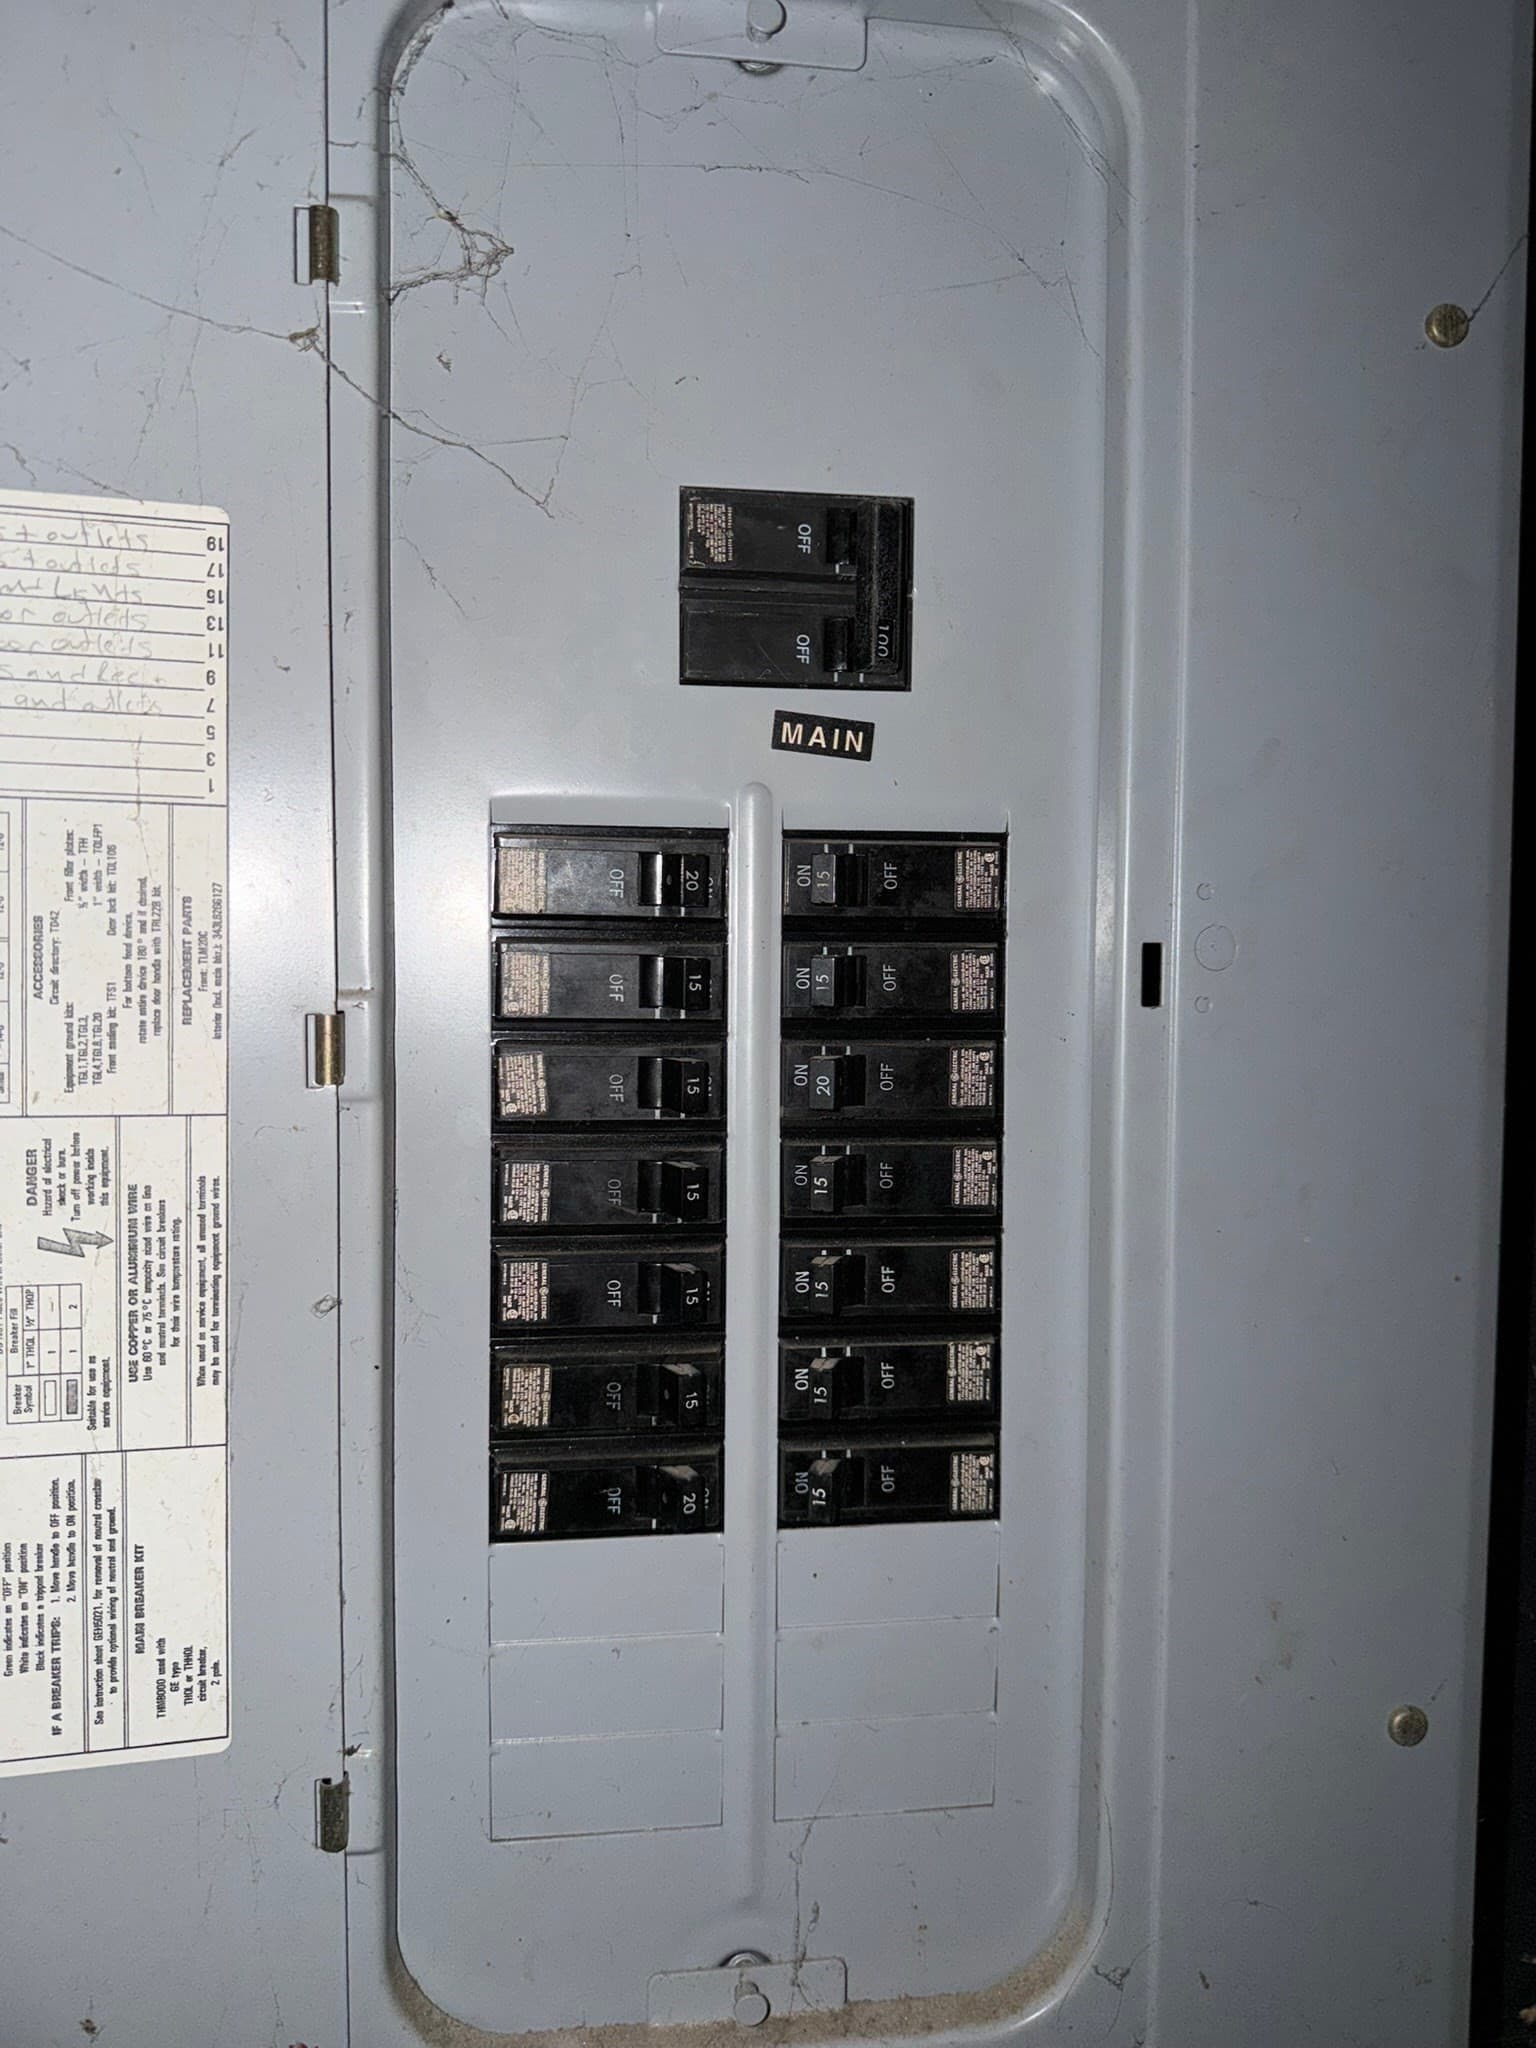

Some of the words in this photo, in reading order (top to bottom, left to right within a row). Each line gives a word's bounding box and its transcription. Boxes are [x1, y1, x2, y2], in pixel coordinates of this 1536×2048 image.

[207, 537, 224, 550] 19
[798, 524, 811, 554] OFF
[207, 563, 224, 578] 17
[207, 589, 223, 603] 15
[206, 616, 223, 631] 13
[208, 643, 223, 658] 11
[796, 635, 809, 664] OFF
[206, 698, 215, 712] 7
[206, 726, 215, 740] 5
[782, 722, 864, 753] MAIN
[206, 753, 215, 766] 3
[609, 869, 624, 898] OFF
[686, 871, 698, 891] 20
[797, 865, 810, 886] ON
[817, 871, 830, 887] 15
[884, 862, 897, 889] OFF
[182, 896, 192, 935] PARTS
[152, 937, 161, 955] with
[33, 916, 43, 1000] ACCESSORIES
[182, 939, 192, 1025] REPLACEMENT
[609, 974, 624, 1002] OFF
[689, 975, 701, 991] 15
[797, 968, 810, 989] ON
[816, 974, 829, 990] 15
[882, 964, 897, 991] OFF
[687, 1078, 700, 1094] 15
[794, 1065, 808, 1086] ON
[817, 1076, 830, 1095] 20
[880, 1063, 893, 1091] OFF
[609, 1074, 624, 1102] OFF
[70, 1132, 80, 1157] before
[85, 1148, 94, 1170] inside
[26, 1149, 37, 1206] DANGER
[73, 1161, 82, 1184] power
[795, 1165, 807, 1185] ON
[880, 1163, 893, 1188] OFF
[57, 1183, 66, 1206] shock
[71, 1189, 80, 1200] off
[85, 1174, 97, 1205] working
[607, 1179, 622, 1206] OFF
[687, 1184, 699, 1200] 15
[814, 1177, 827, 1195] 15
[42, 1189, 52, 1216] Hazard
[100, 1192, 109, 1206] this
[128, 1184, 138, 1215] WIRE
[70, 1204, 80, 1222] Turn
[211, 1203, 222, 1229] ground
[212, 1233, 222, 1271] equipment
[795, 1271, 809, 1293] ON
[815, 1282, 828, 1298] 15
[881, 1266, 895, 1293] OFF
[128, 1289, 138, 1306] OR
[210, 1274, 222, 1317] terminating
[607, 1280, 621, 1307] OFF
[686, 1288, 699, 1304] 15
[10, 1323, 18, 1353] Breaker
[128, 1310, 138, 1356] COPPER
[129, 1360, 138, 1383] USE
[795, 1369, 808, 1390] ON
[881, 1362, 894, 1388] OFF
[24, 1385, 34, 1413] Symbol
[87, 1385, 96, 1396] for
[607, 1382, 621, 1410] OFF
[686, 1392, 698, 1408] 15
[814, 1386, 827, 1404] 15
[87, 1400, 97, 1430] Suitable
[101, 1401, 110, 1428] service
[795, 1472, 808, 1494] ON
[881, 1465, 894, 1492] OFF
[684, 1493, 696, 1514] 20
[813, 1488, 825, 1505] 15
[2, 1543, 13, 1573] position
[50, 1543, 60, 1568] handle
[134, 1544, 144, 1562] KIT
[134, 1566, 145, 1619] BREAKER
[135, 1623, 145, 1654] MAIN
[156, 1638, 165, 1655] with
[19, 1652, 29, 1674] White
[51, 1657, 61, 1709] BREAKER
[52, 1713, 62, 1721] A
[52, 1726, 62, 1736] IF
